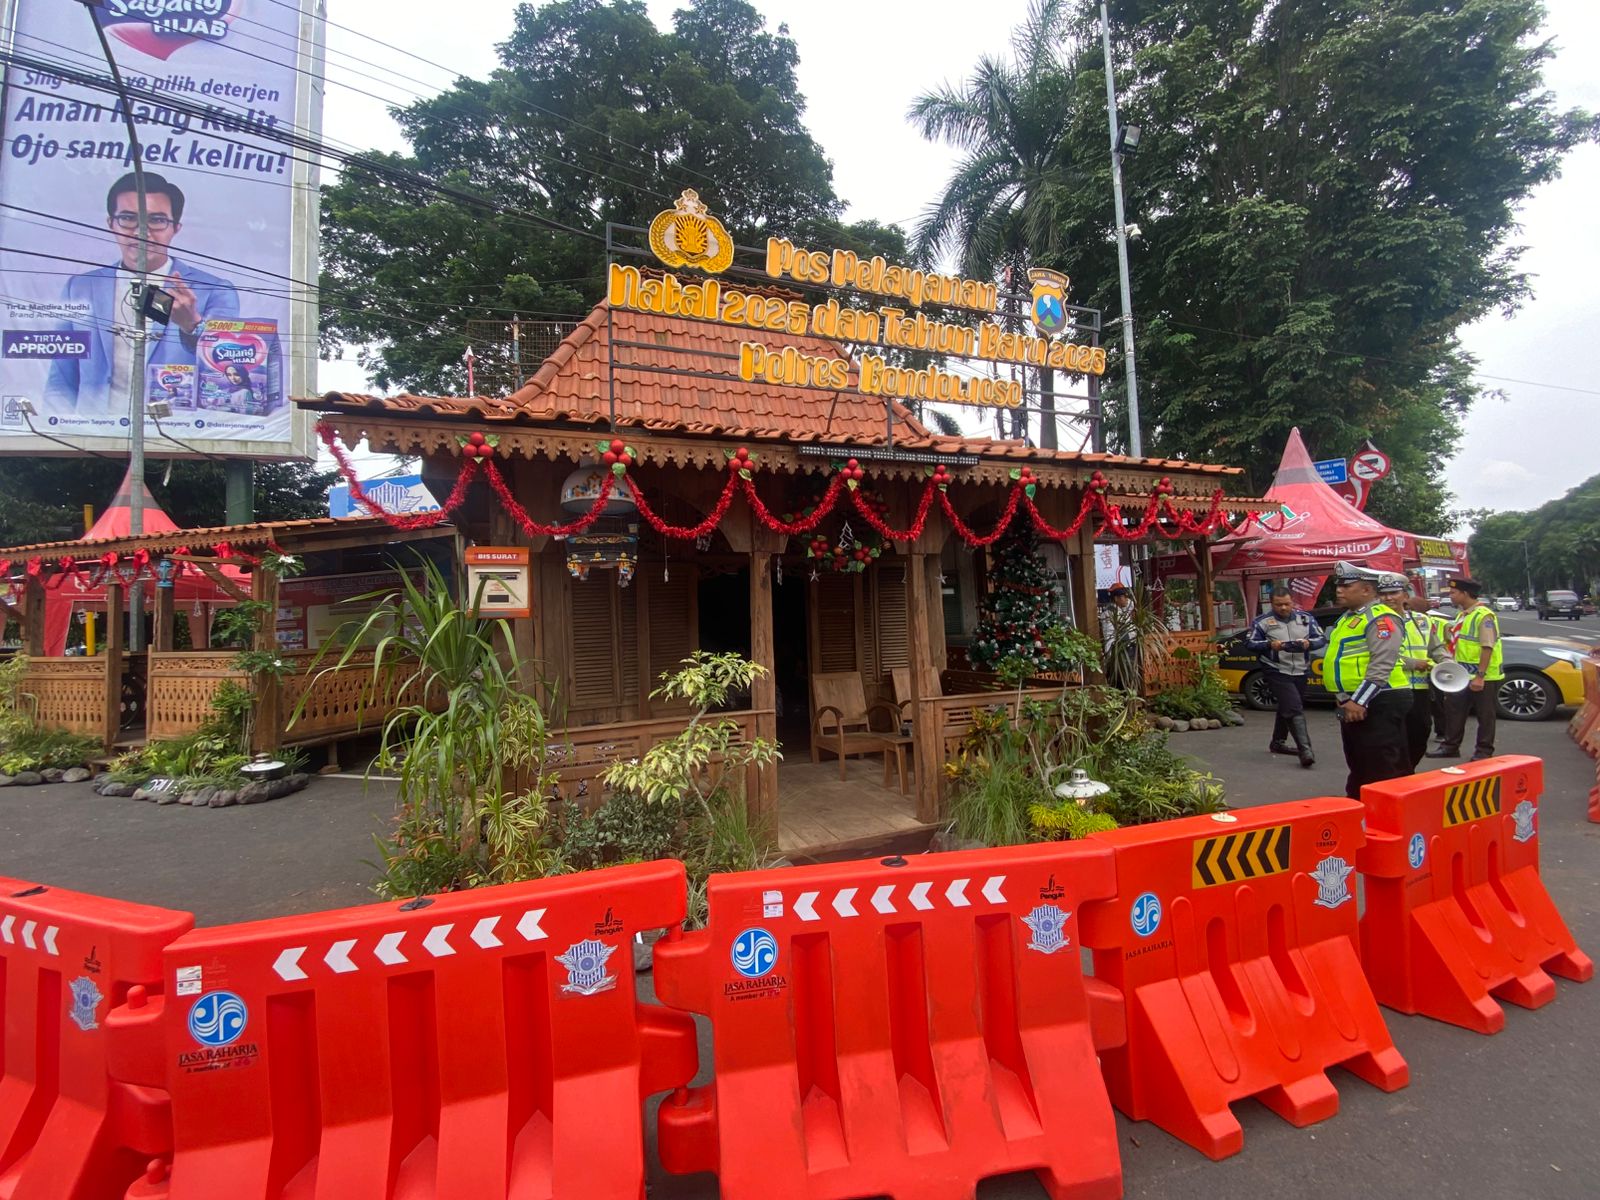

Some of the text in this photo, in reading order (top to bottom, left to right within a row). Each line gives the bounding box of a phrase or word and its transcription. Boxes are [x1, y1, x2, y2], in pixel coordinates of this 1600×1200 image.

[153, 19, 226, 37] HIJAB
[152, 74, 195, 94] pilih
[200, 79, 279, 102] deterjen
[15, 97, 101, 122] Aman
[110, 98, 191, 135] Nang
[11, 134, 288, 174] Ojo sampek keliru!
[766, 237, 998, 313] Pos Pelayanan
[609, 263, 1106, 375] Natal 2025 dan Tahun Baru 2026
[8, 343, 86, 354] APPROVED
[215, 348, 254, 360] Sayang
[738, 341, 1023, 409] Polres Bondowoso
[1302, 542, 1371, 556] bankjatim
[1040, 892, 1065, 900] Penguin
[595, 926, 624, 936] Penguin
[724, 976, 787, 995] JASA RAHARJA
[179, 1044, 258, 1065] JASA RAHARJA
